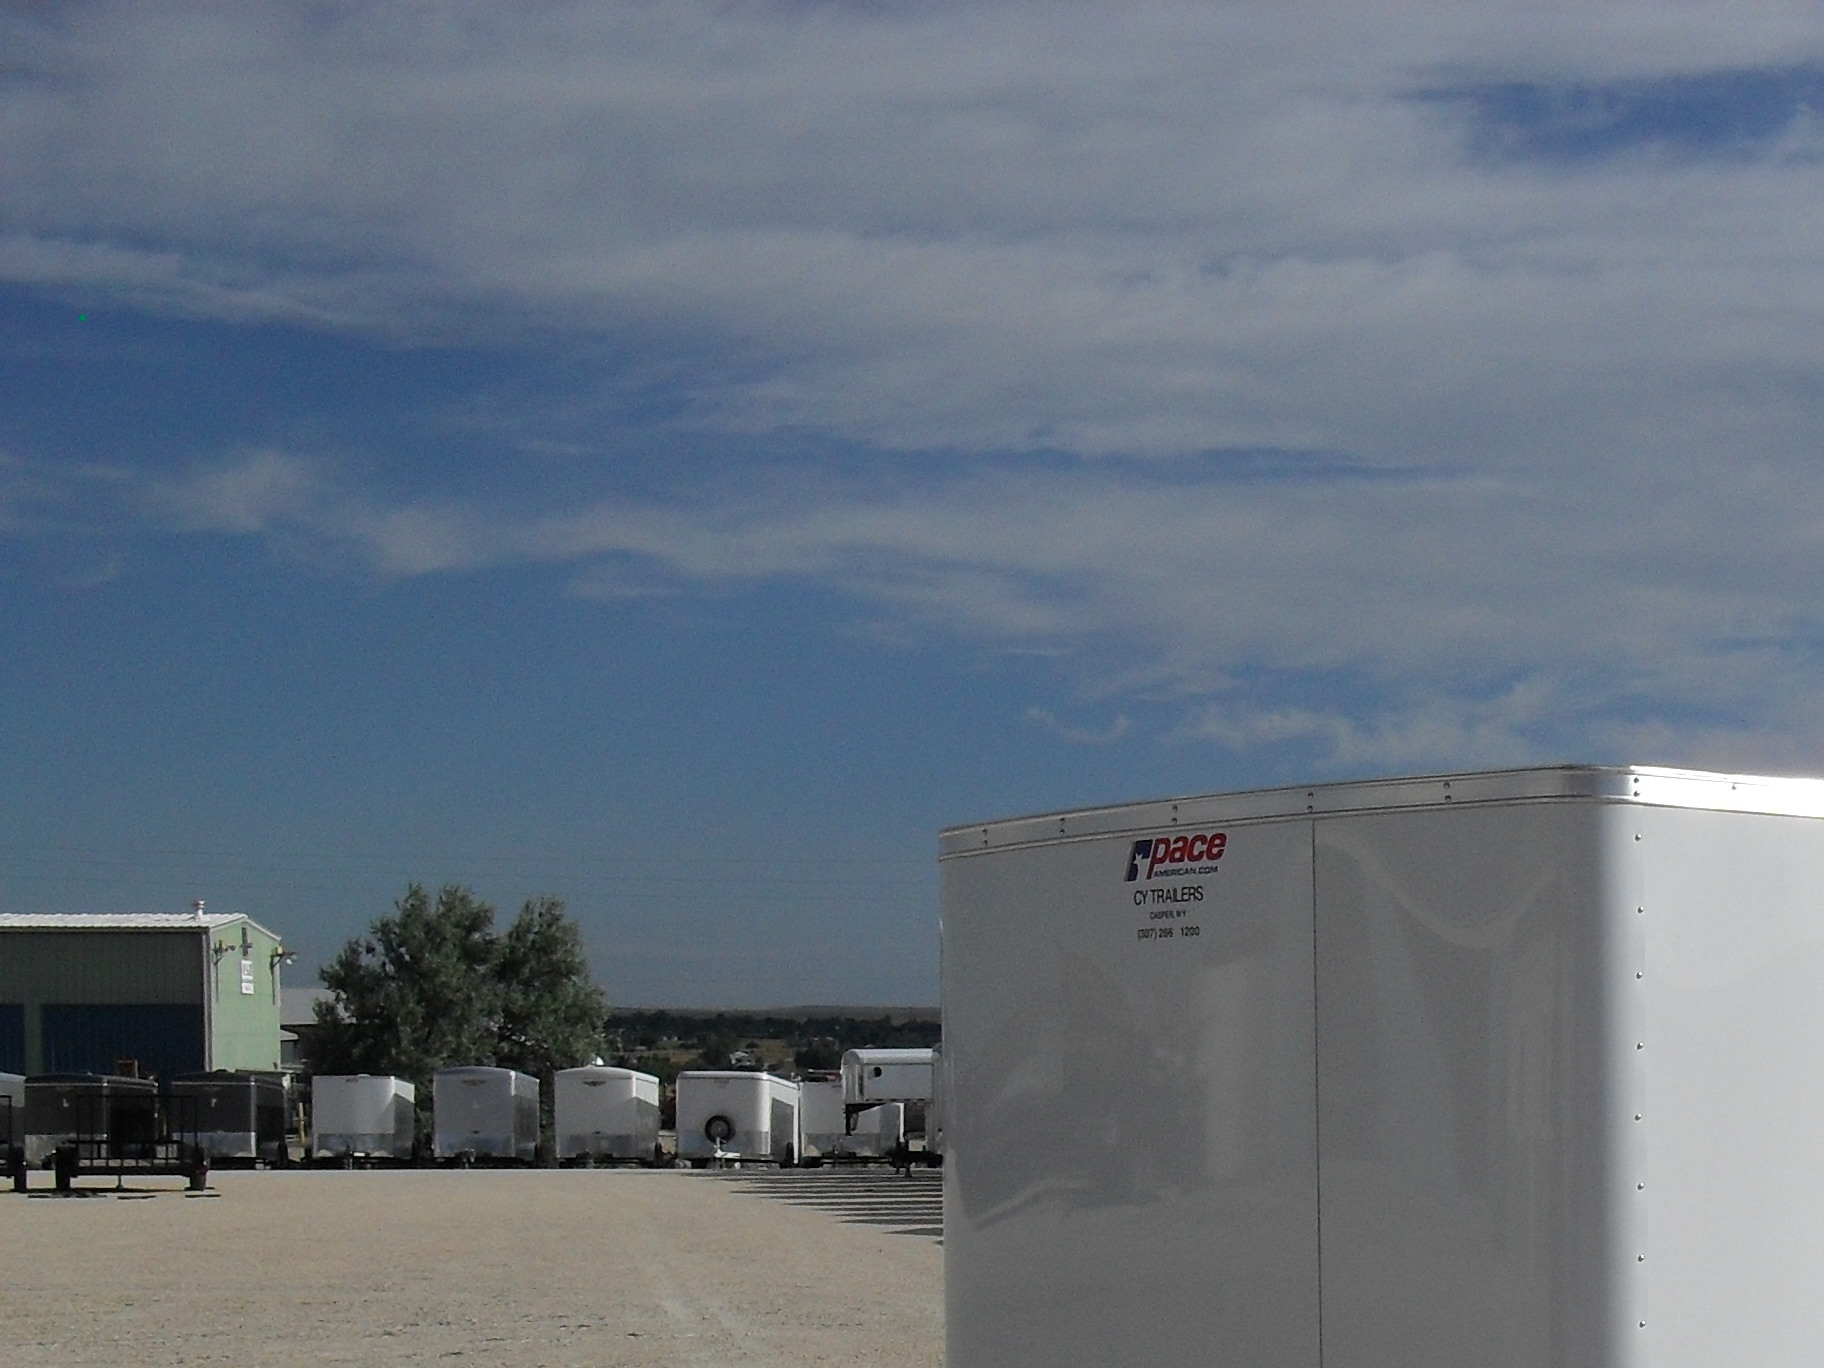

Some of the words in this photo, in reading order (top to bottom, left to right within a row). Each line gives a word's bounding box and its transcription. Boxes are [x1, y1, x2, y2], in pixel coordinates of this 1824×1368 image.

[1146, 832, 1227, 880] pace
[1133, 890, 1148, 906] CY
[1150, 885, 1204, 904] TRAILERS
